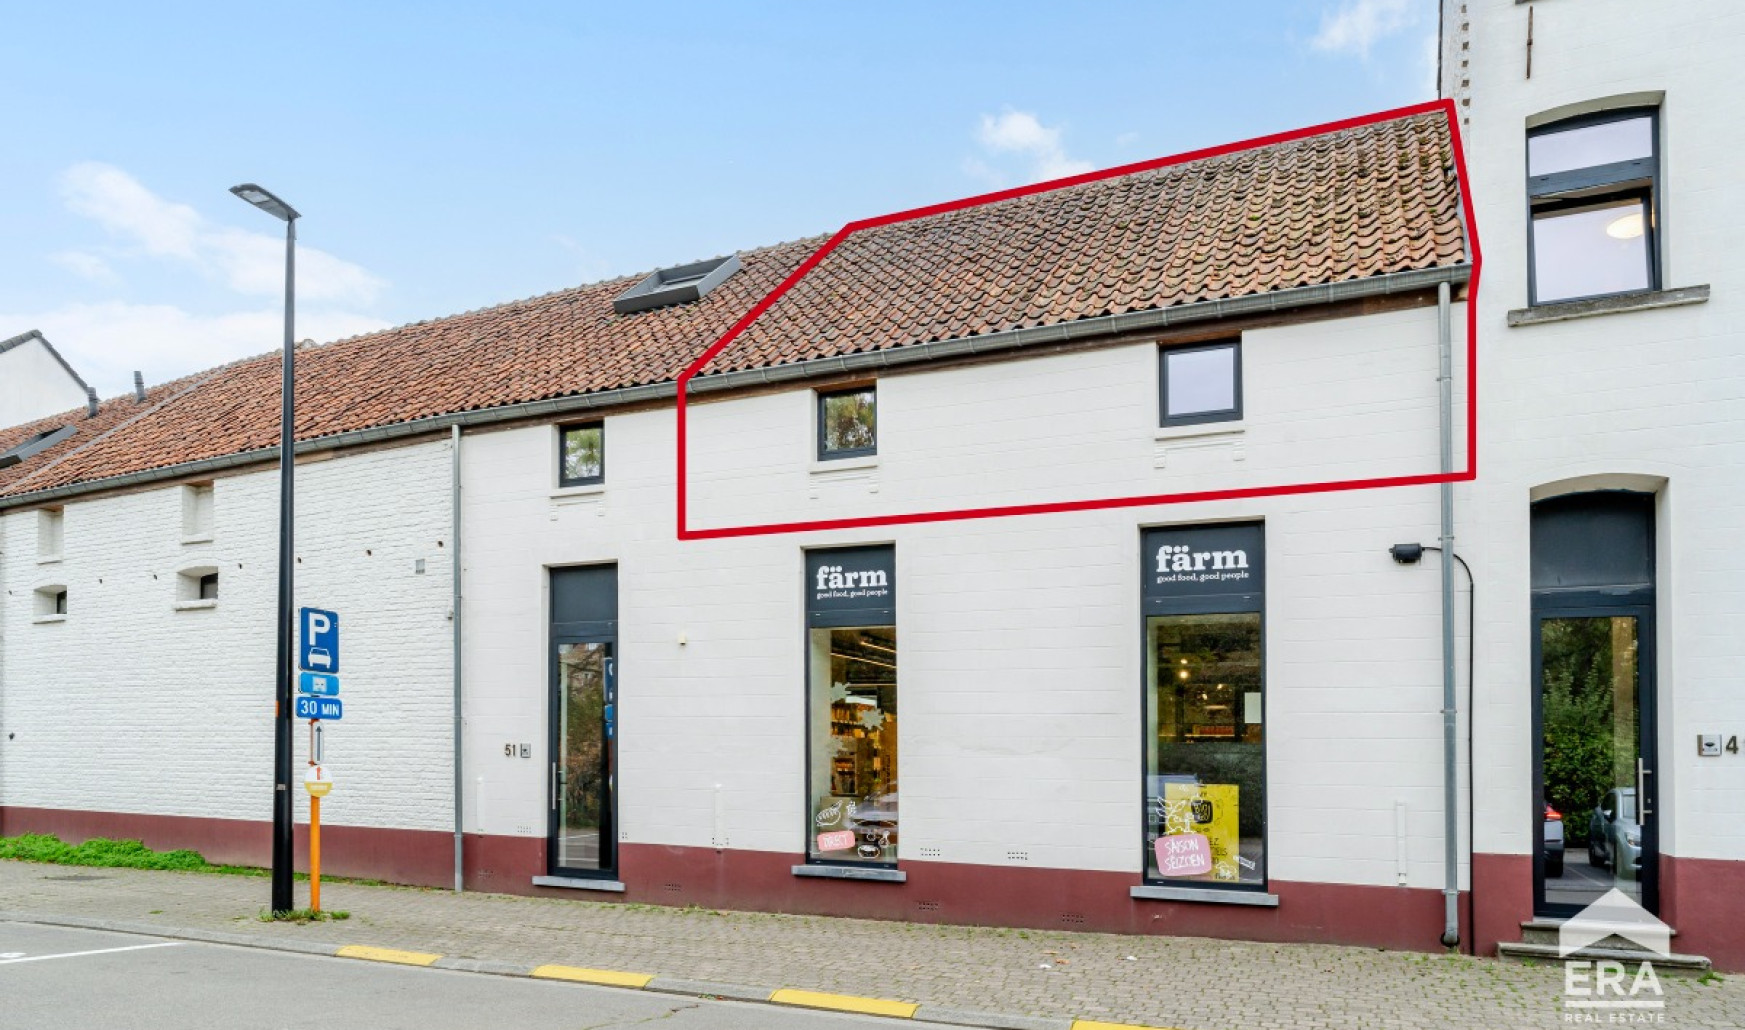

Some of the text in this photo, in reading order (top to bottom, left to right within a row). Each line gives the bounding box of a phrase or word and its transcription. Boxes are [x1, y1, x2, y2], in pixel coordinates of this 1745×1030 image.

[1155, 544, 1249, 573] färm
[816, 565, 888, 590] färm
[1156, 570, 1250, 584] good food, good people
[816, 590, 833, 600] good
[850, 588, 866, 599] good
[866, 587, 888, 598] people
[309, 612, 331, 647] P
[300, 700, 340, 717] 30 MIN
[504, 743, 516, 757] 51
[1164, 839, 1199, 855] SAISON
[1164, 854, 1205, 871] SEIZOEN
